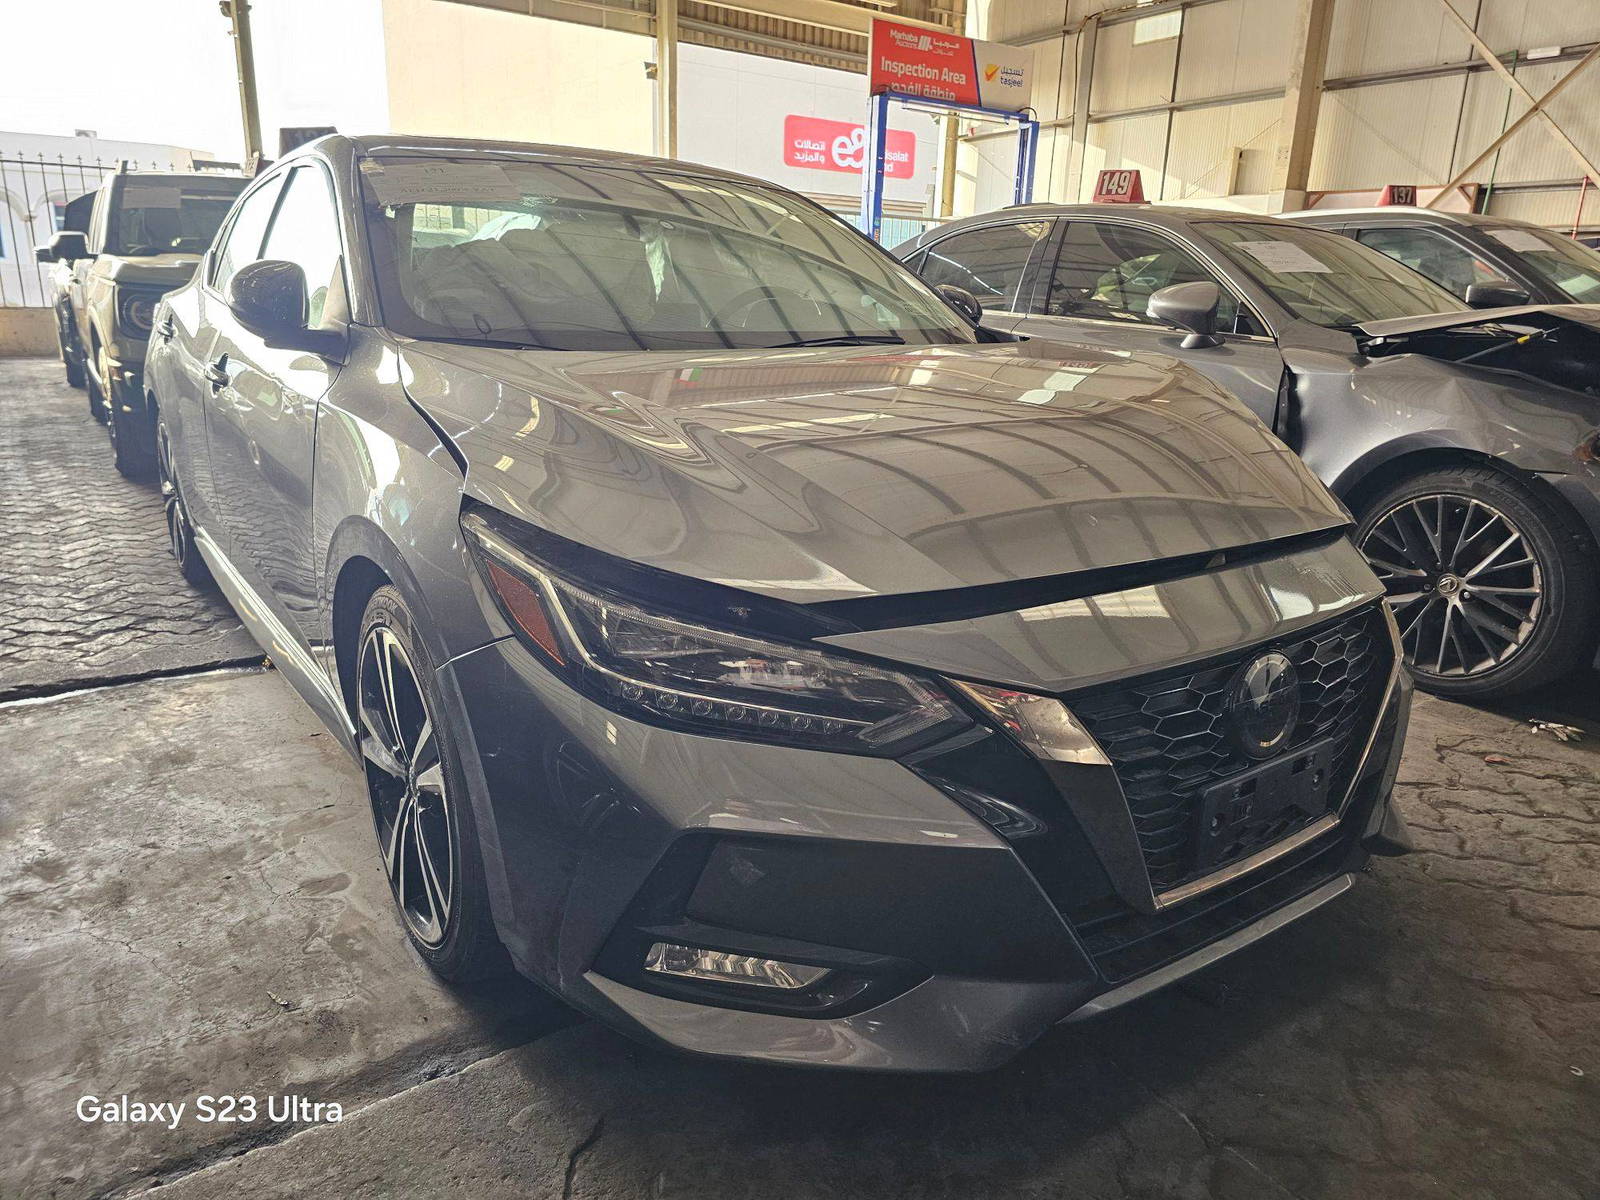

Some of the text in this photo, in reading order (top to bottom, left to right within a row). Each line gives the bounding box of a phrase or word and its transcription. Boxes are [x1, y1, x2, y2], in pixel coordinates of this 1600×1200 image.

[881, 56, 967, 85] Inspection Area
[1101, 172, 1130, 195] 149
[1393, 187, 1412, 203] 137
